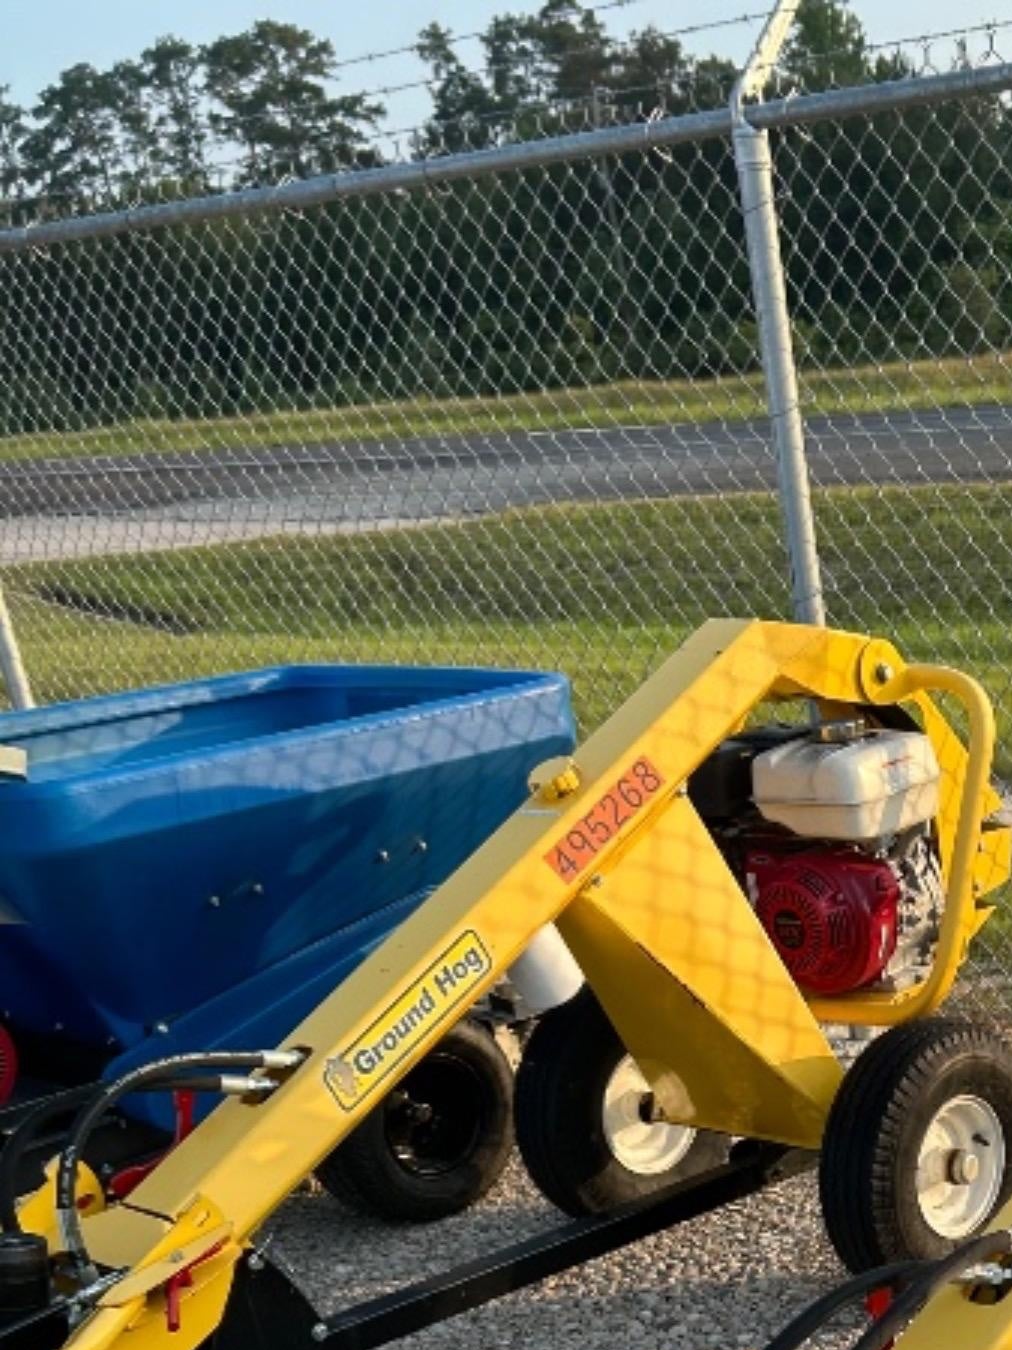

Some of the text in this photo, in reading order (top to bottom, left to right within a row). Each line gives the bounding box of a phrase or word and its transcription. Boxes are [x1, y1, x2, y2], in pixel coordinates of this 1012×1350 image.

[555, 761, 661, 873] 495268
[353, 947, 483, 1074] Ground Hog
